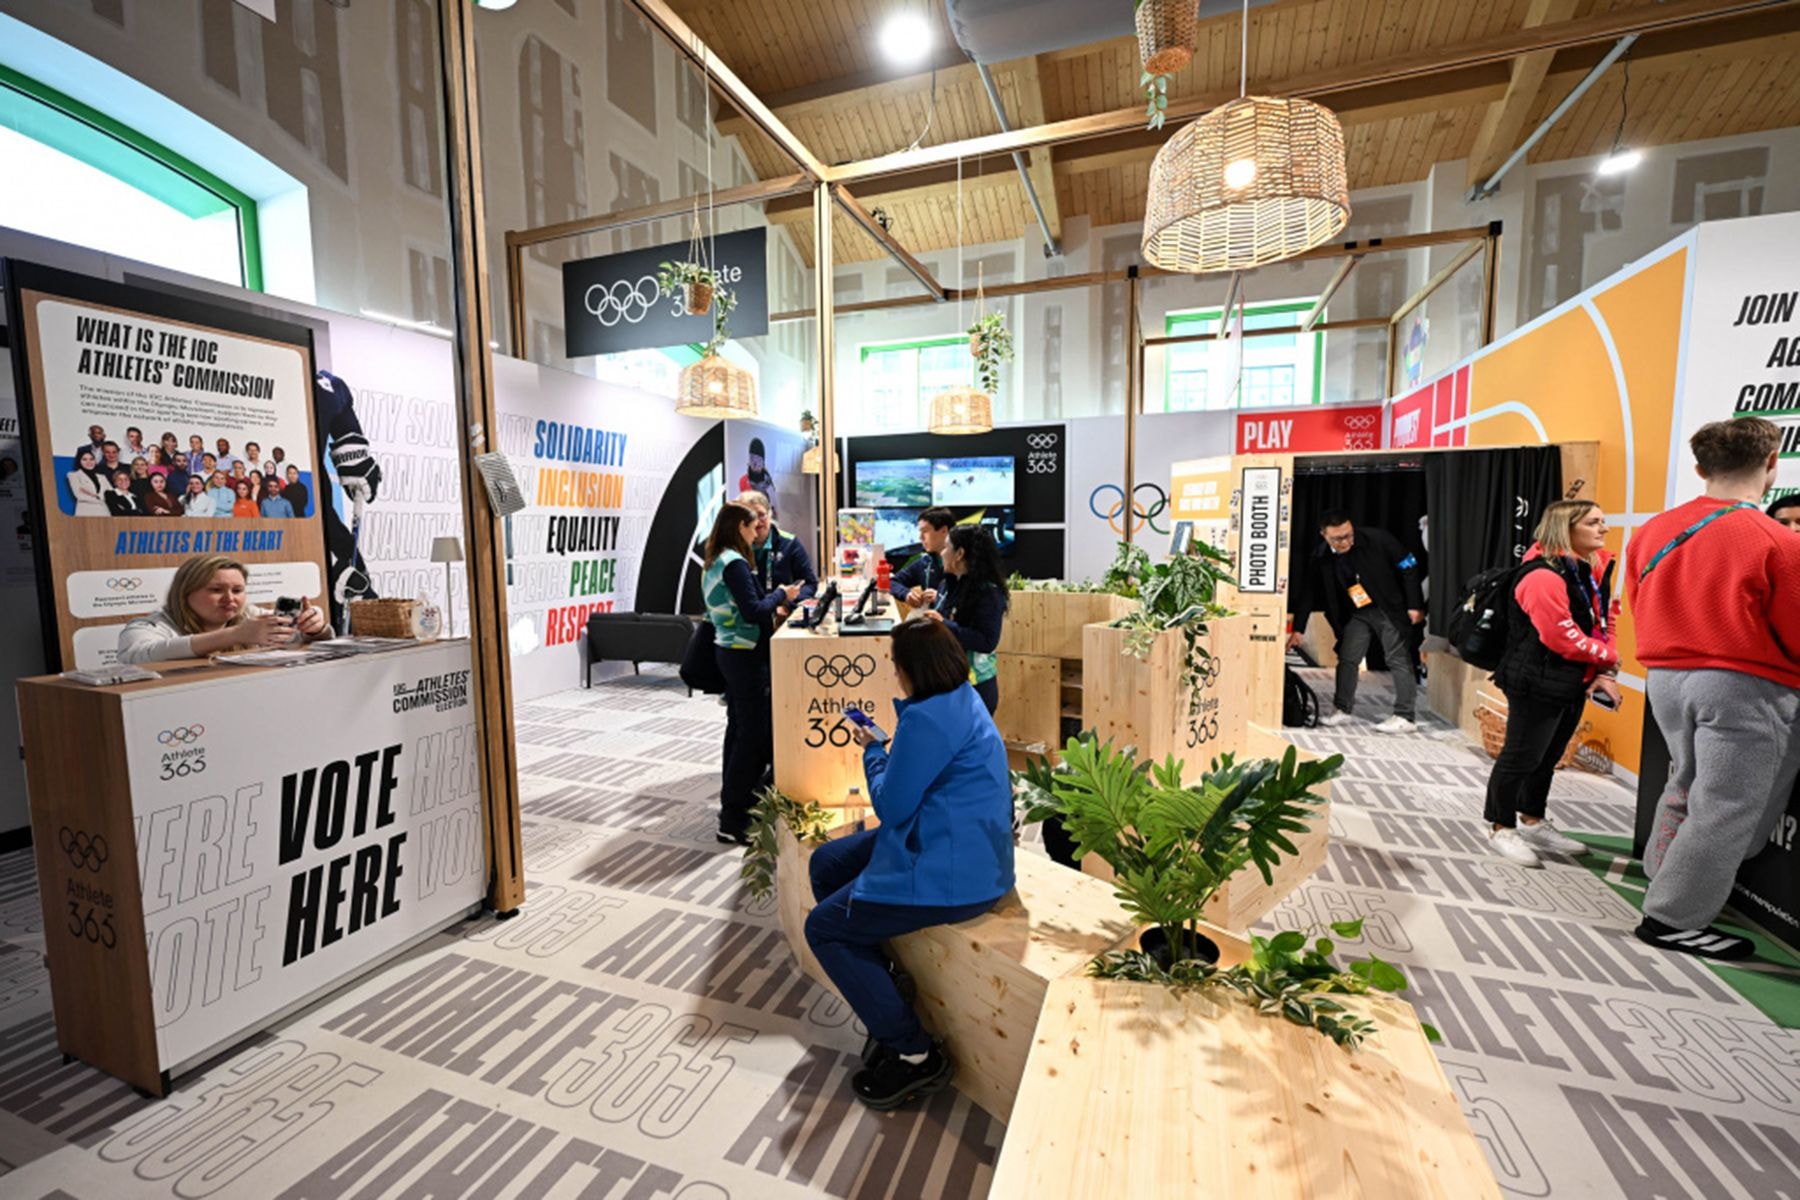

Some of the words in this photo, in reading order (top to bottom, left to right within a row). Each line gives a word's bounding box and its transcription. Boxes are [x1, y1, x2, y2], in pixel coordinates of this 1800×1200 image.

[1733, 291, 1799, 327] JOIN
[76, 316, 132, 348] WHAT
[135, 326, 155, 353] IS
[158, 331, 188, 360] THE
[190, 338, 219, 364] IOC
[173, 365, 275, 400] COMMISSION
[1735, 382, 1800, 412] COM
[534, 419, 627, 468] SOLIDARITY
[1244, 419, 1293, 449] PLAY
[1026, 459, 1057, 474] 365
[537, 467, 624, 509] INCLUSION
[546, 515, 620, 556] EQUALITY
[1250, 495, 1269, 539] BOOTH
[115, 531, 191, 555] ATHLETES
[192, 531, 214, 554] AT
[215, 531, 241, 553] THE
[242, 530, 283, 552] HEART
[569, 558, 617, 597] PEACE
[1248, 543, 1267, 587] PHOTO
[546, 601, 613, 647] RESP
[393, 685, 467, 714] COMMISSION
[804, 717, 864, 748] 36
[1186, 711, 1219, 748] 365
[159, 757, 207, 781] 365
[161, 746, 205, 763] Athlete
[409, 722, 480, 817] HER
[278, 743, 403, 865] VOTE
[134, 782, 263, 917] ERE
[417, 800, 484, 902] VOT
[66, 877, 113, 909] Athlete
[282, 832, 408, 967] HERE
[67, 901, 117, 949] 365
[146, 885, 271, 1031] OTE
[320, 954, 638, 1097] ATHLETE
[545, 1003, 759, 1139] 365
